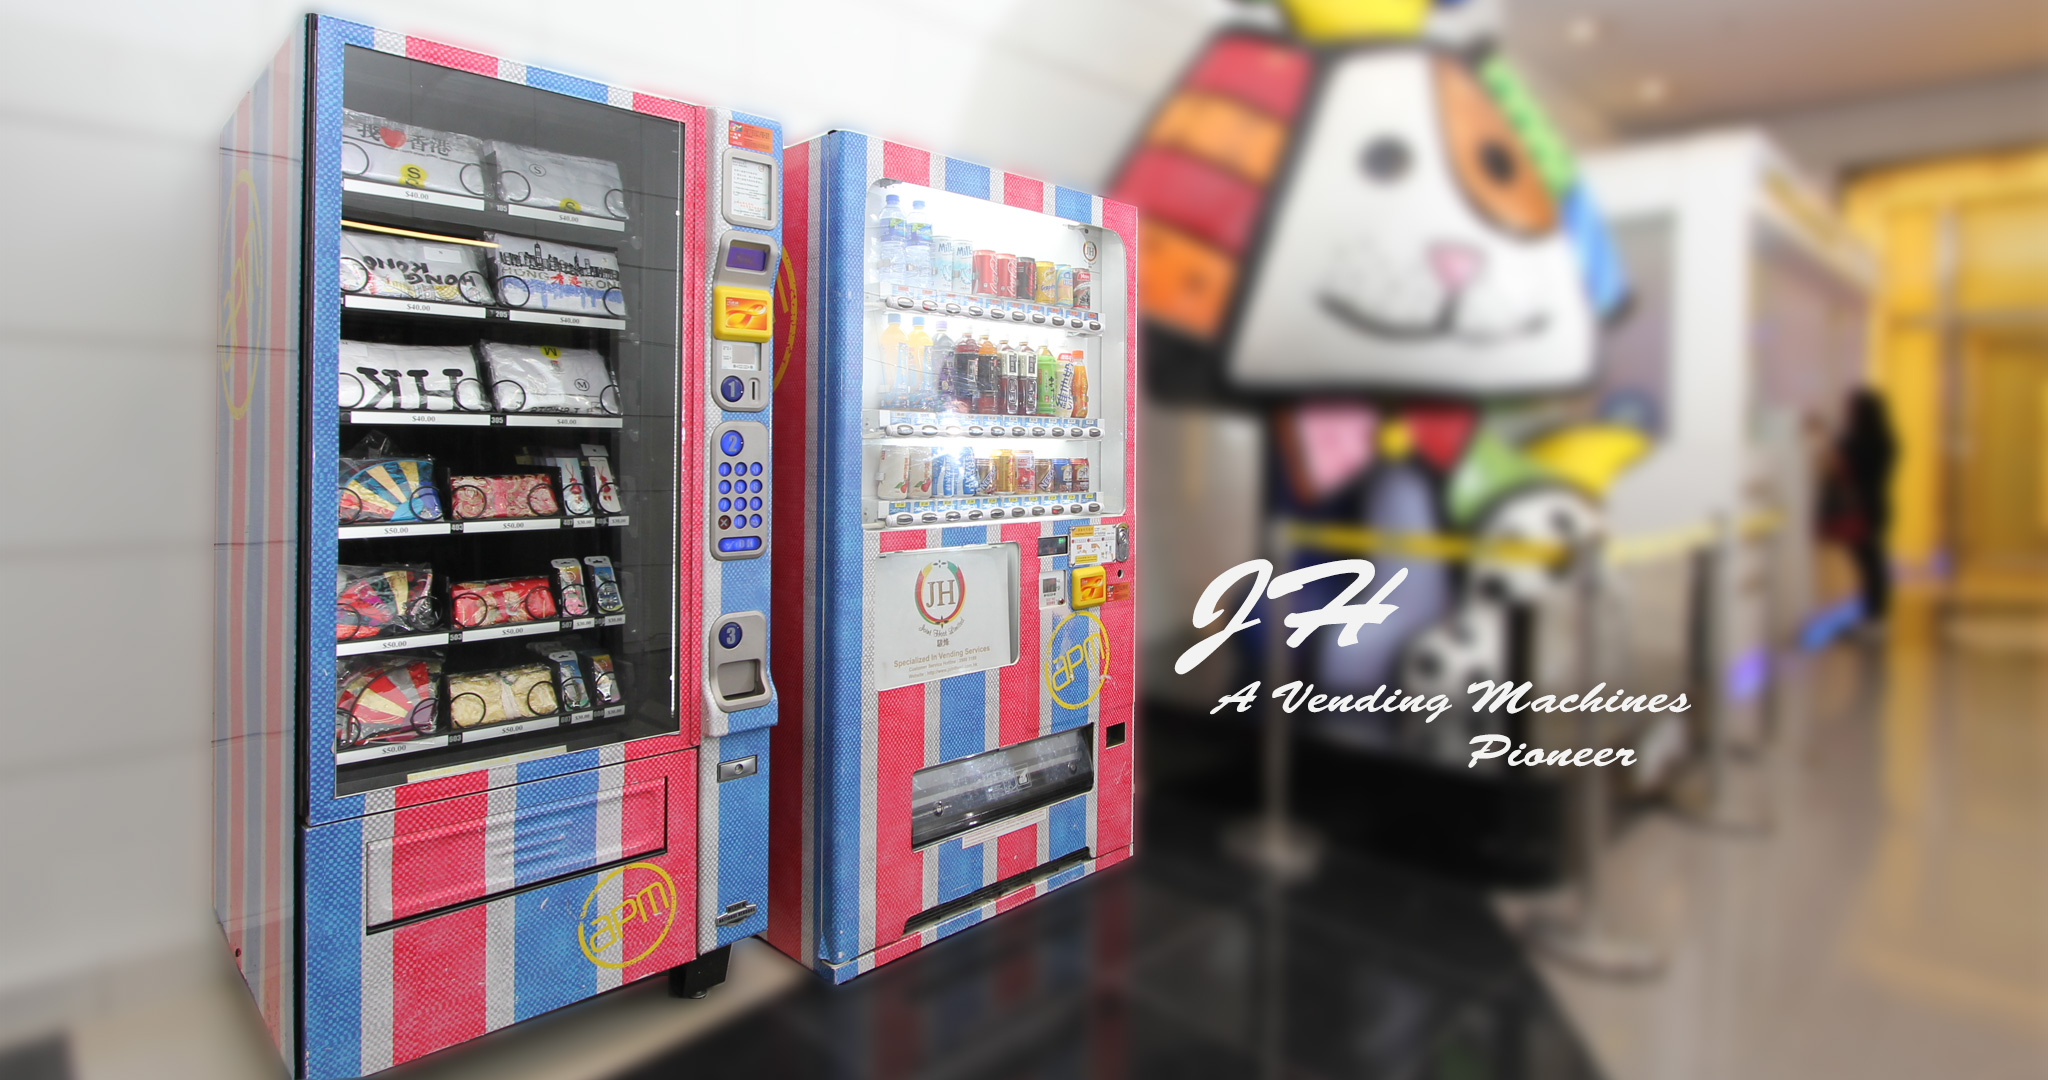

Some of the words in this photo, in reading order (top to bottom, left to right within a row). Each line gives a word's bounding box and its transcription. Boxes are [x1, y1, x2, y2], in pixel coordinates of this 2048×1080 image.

[410, 135, 450, 156] 香港
[407, 166, 421, 179] S
[405, 191, 429, 200] $40.00
[501, 267, 550, 280] HONG
[406, 304, 431, 312] $40.00
[495, 310, 508, 318] 205
[728, 381, 736, 398] 1
[491, 416, 504, 424] 305
[728, 435, 738, 452] 2
[384, 527, 409, 535] $50.00
[926, 580, 956, 608] JH
[502, 627, 523, 636] $50.00
[726, 627, 736, 645] 3
[450, 633, 462, 642] 503
[382, 640, 407, 649] $50.00
[894, 655, 930, 668] Specialized
[938, 650, 963, 660] Vending
[965, 646, 990, 655] Services
[1052, 632, 1105, 691] apm
[502, 725, 523, 734] $50.00
[381, 745, 407, 755] $50.00
[590, 881, 670, 953] apm
